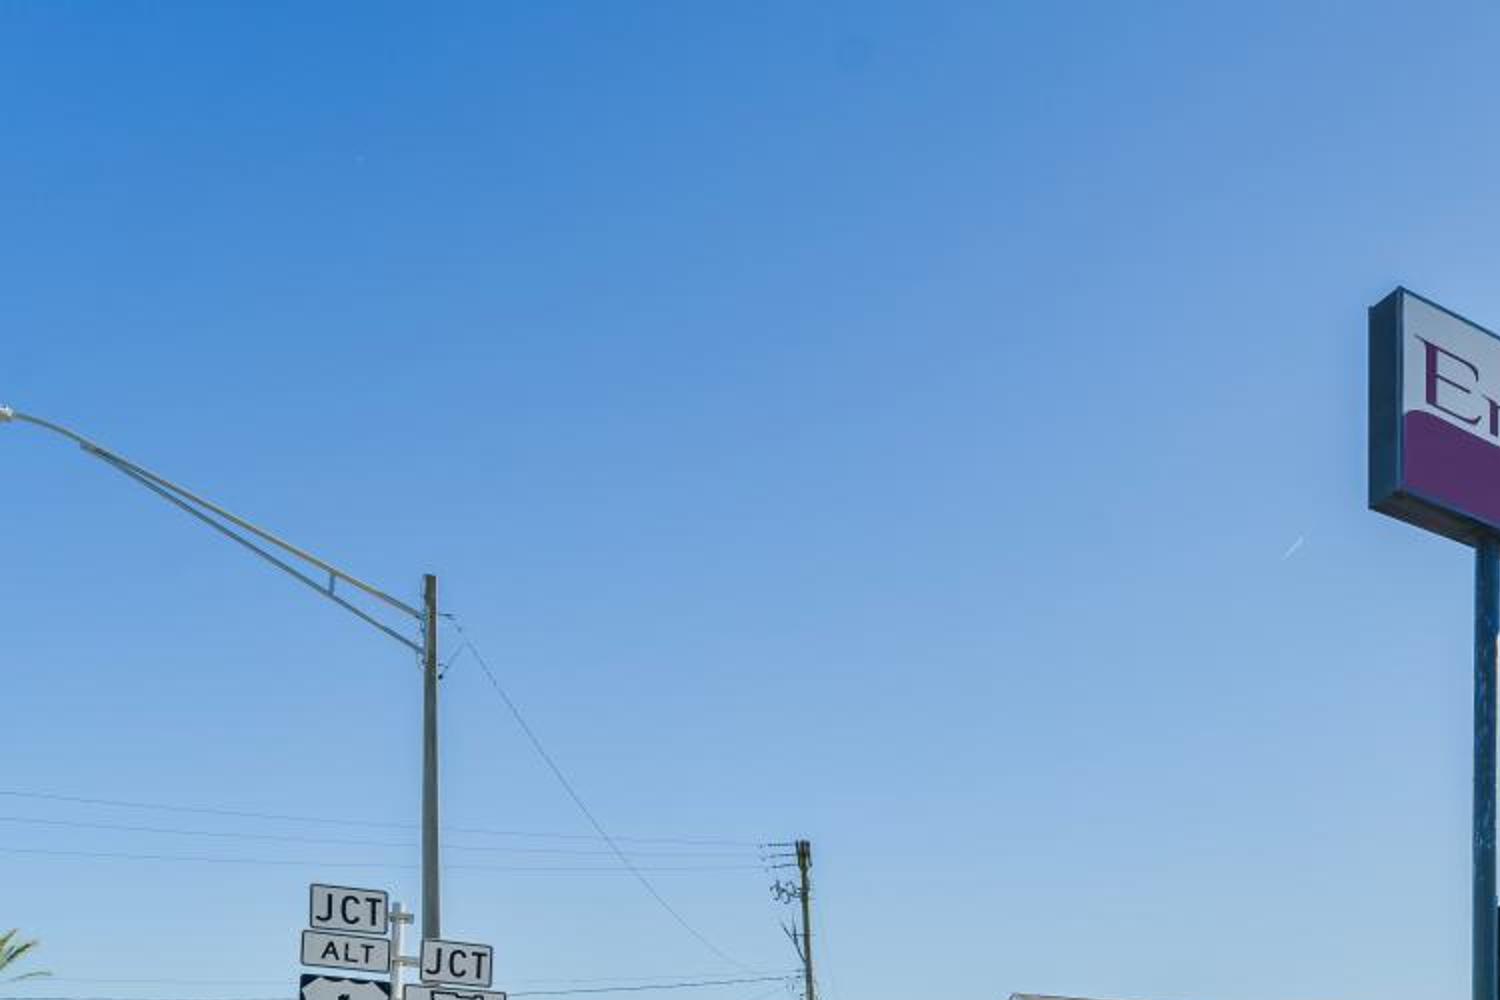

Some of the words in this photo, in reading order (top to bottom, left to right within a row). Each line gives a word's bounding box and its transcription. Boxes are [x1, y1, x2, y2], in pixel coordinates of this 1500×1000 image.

[315, 893, 383, 926] JCT
[321, 941, 375, 964] ALT
[425, 947, 488, 979] JCT
